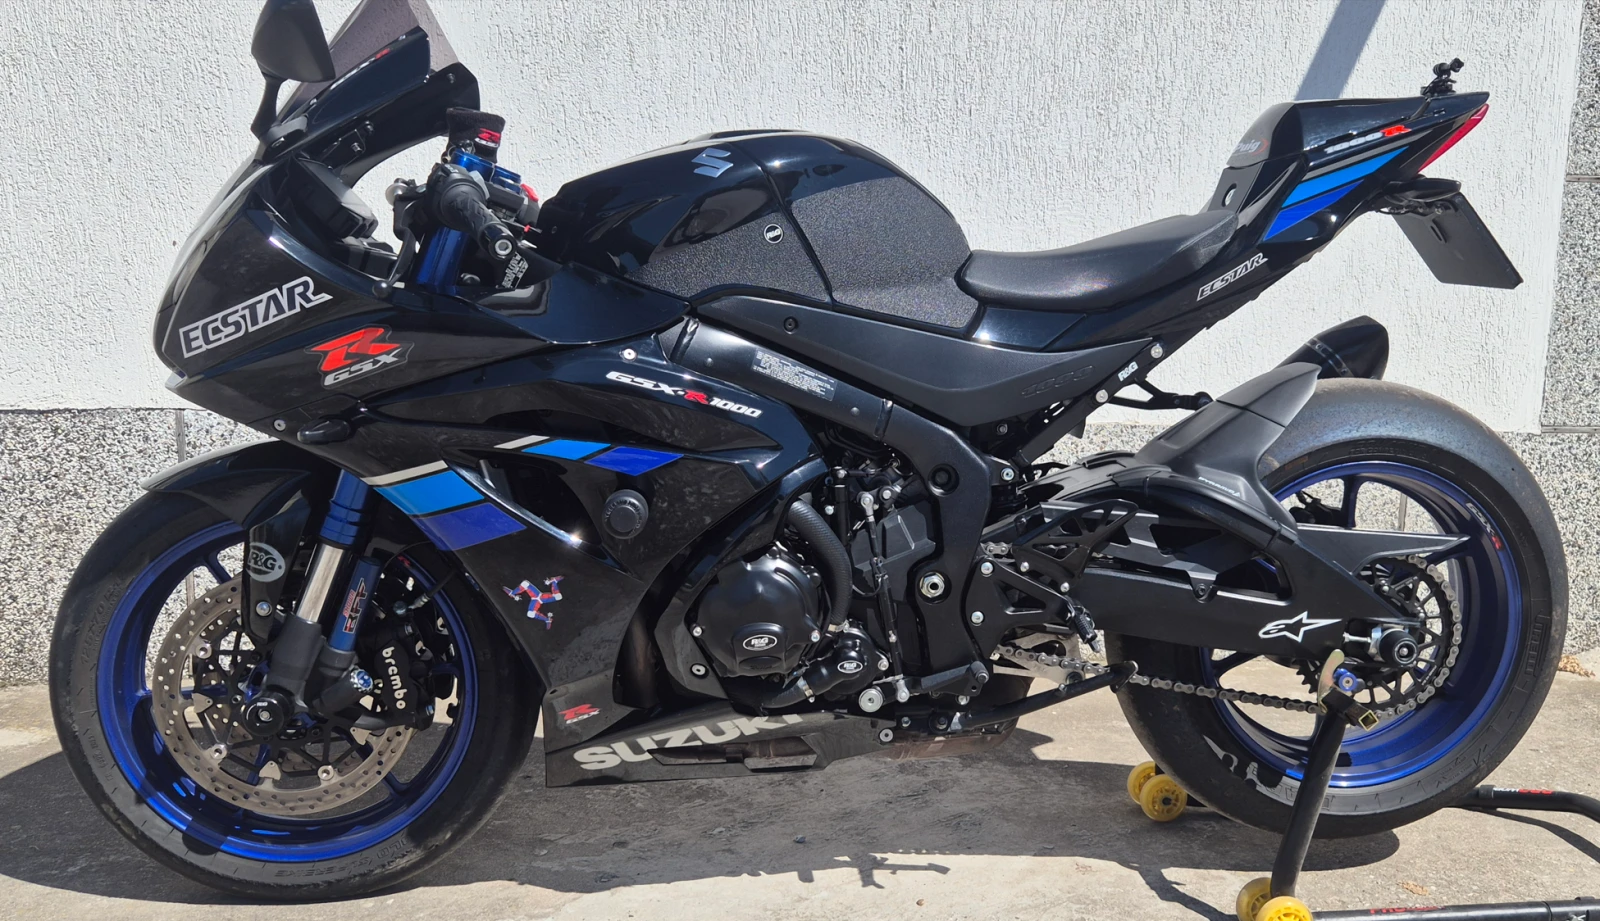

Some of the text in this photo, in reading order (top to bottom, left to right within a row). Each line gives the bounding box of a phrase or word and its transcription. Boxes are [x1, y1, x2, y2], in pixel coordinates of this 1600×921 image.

[1196, 252, 1268, 301] ECSTAR
[178, 275, 334, 359] ECSTAR
[323, 347, 402, 387] GSX
[1117, 361, 1139, 382] R&G
[247, 549, 278, 574] R&G
[381, 646, 407, 710] brembo
